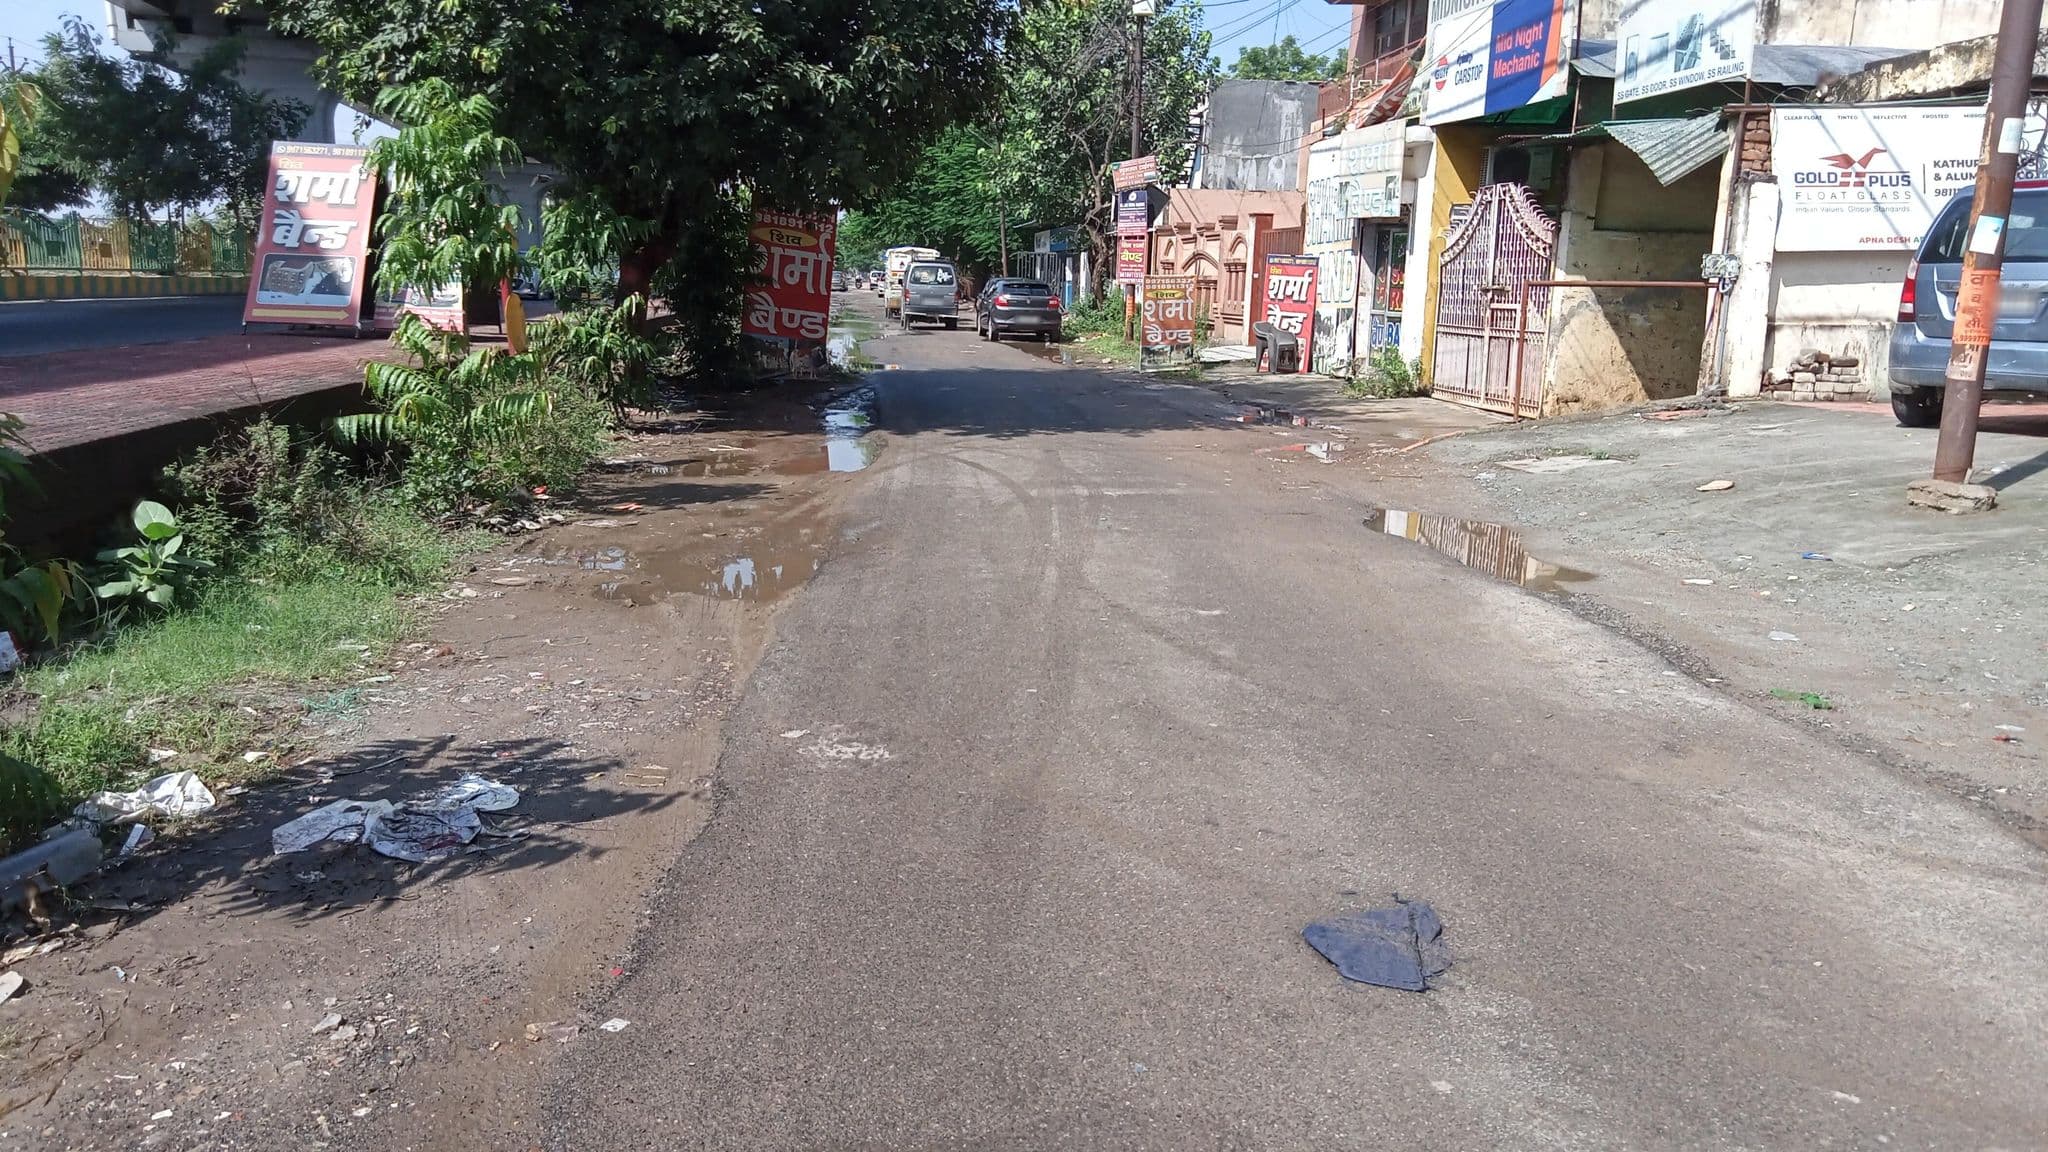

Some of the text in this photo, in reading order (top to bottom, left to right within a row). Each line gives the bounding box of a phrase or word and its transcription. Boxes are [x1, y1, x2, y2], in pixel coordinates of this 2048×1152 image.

[1495, 21, 1544, 54] Mid Night
[1454, 64, 1484, 86] CARSTOP
[1493, 50, 1540, 79] Mechanic
[1617, 91, 1625, 101] SS
[1642, 85, 1650, 94] SS
[1669, 78, 1678, 88] SS
[1707, 69, 1716, 79] SS
[1717, 62, 1745, 77] RAILING
[274, 163, 368, 206] शर्मा
[1794, 171, 1911, 187] GOLD PLUS
[1933, 173, 1941, 181] &
[1795, 191, 1911, 200] FLOAT GLASS
[768, 229, 803, 246] शिव
[1859, 236, 1884, 244] APNA
[1886, 236, 1911, 244] DESH
[1268, 270, 1314, 301] शर्मा
[750, 291, 828, 340] बैण्ड
[1144, 288, 1194, 321] शर्मा
[1143, 323, 1194, 344] बैण्ड
